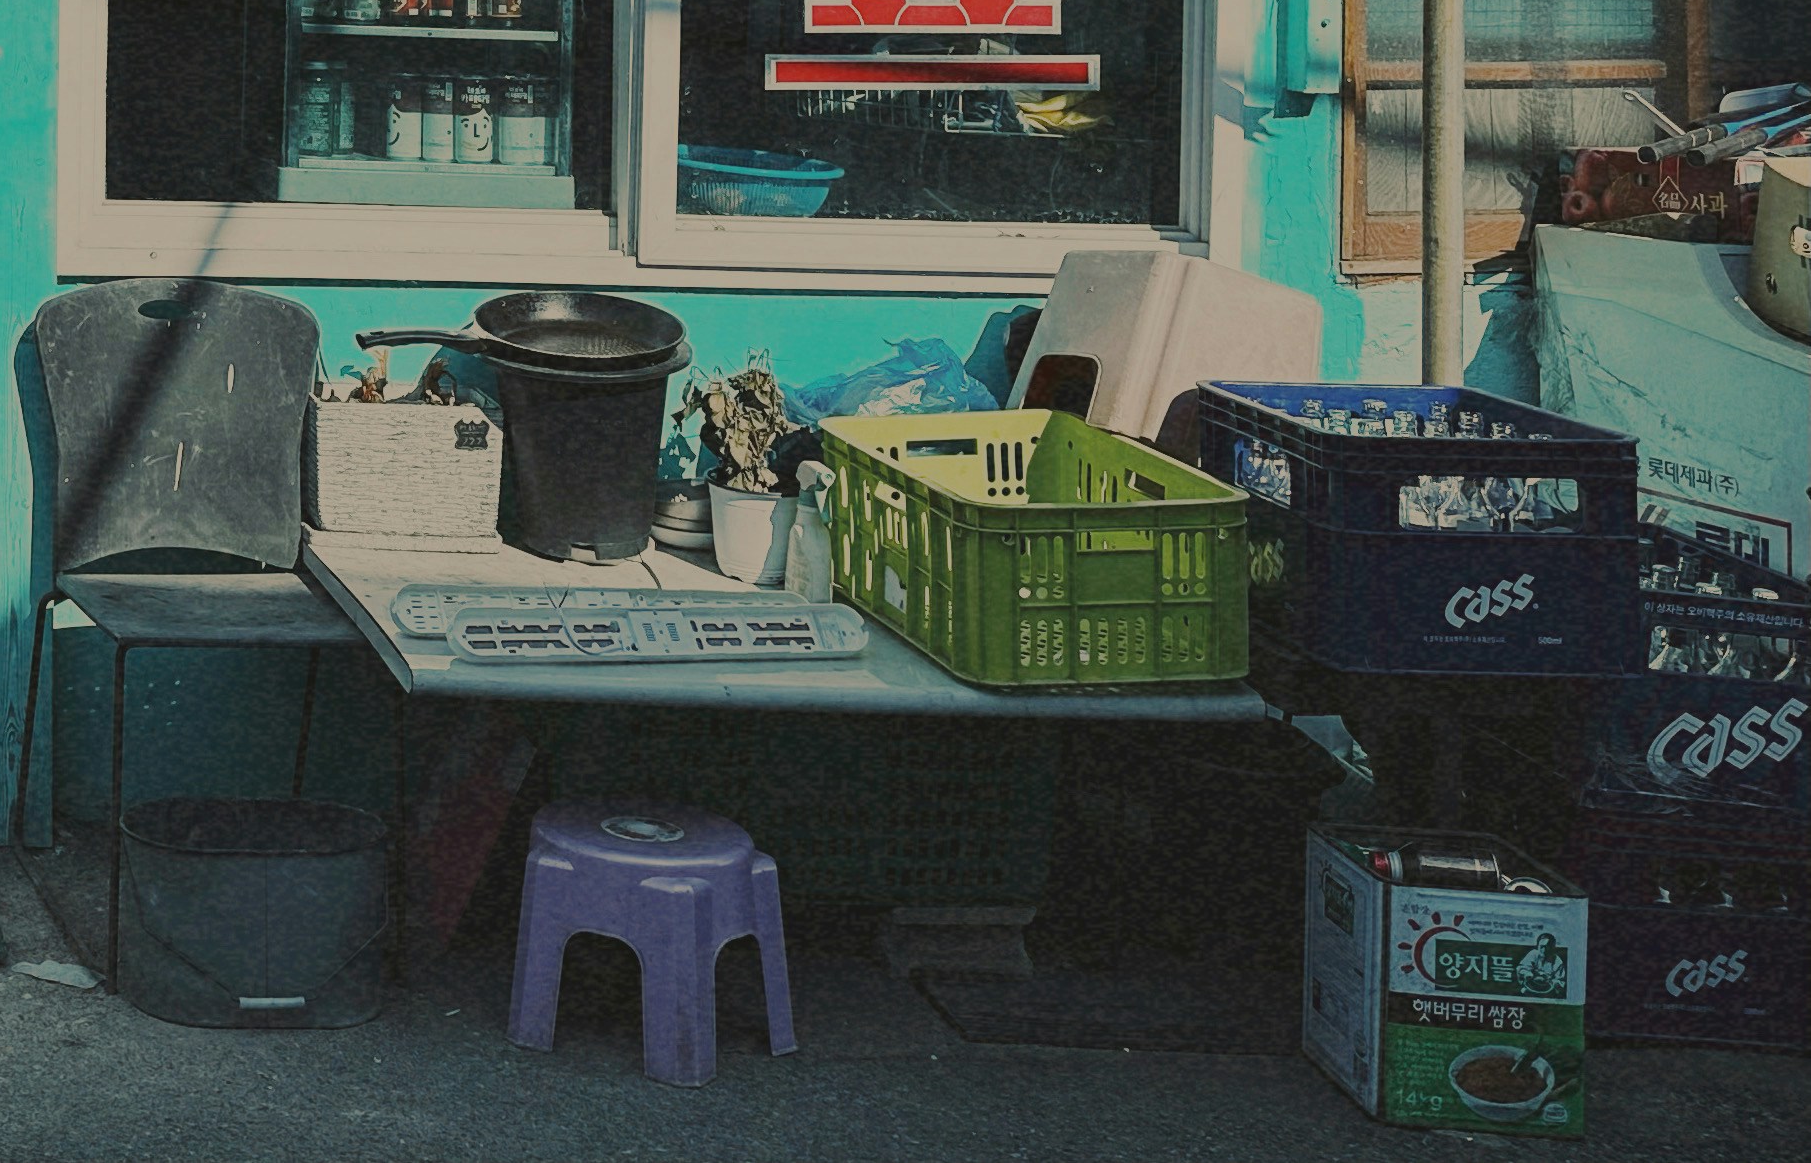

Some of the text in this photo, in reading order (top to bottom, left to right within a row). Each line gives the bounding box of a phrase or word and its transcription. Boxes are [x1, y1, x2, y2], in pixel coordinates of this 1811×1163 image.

[1690, 191, 1729, 219] 사과
[1648, 457, 1739, 497] 롯데제과(주)
[1248, 537, 1285, 586] ass
[1644, 601, 1654, 613] 이
[1657, 602, 1685, 615] 상자는
[1439, 952, 1514, 983] 양지뜰
[1412, 998, 1527, 1030] 햇버무리 쌈장
